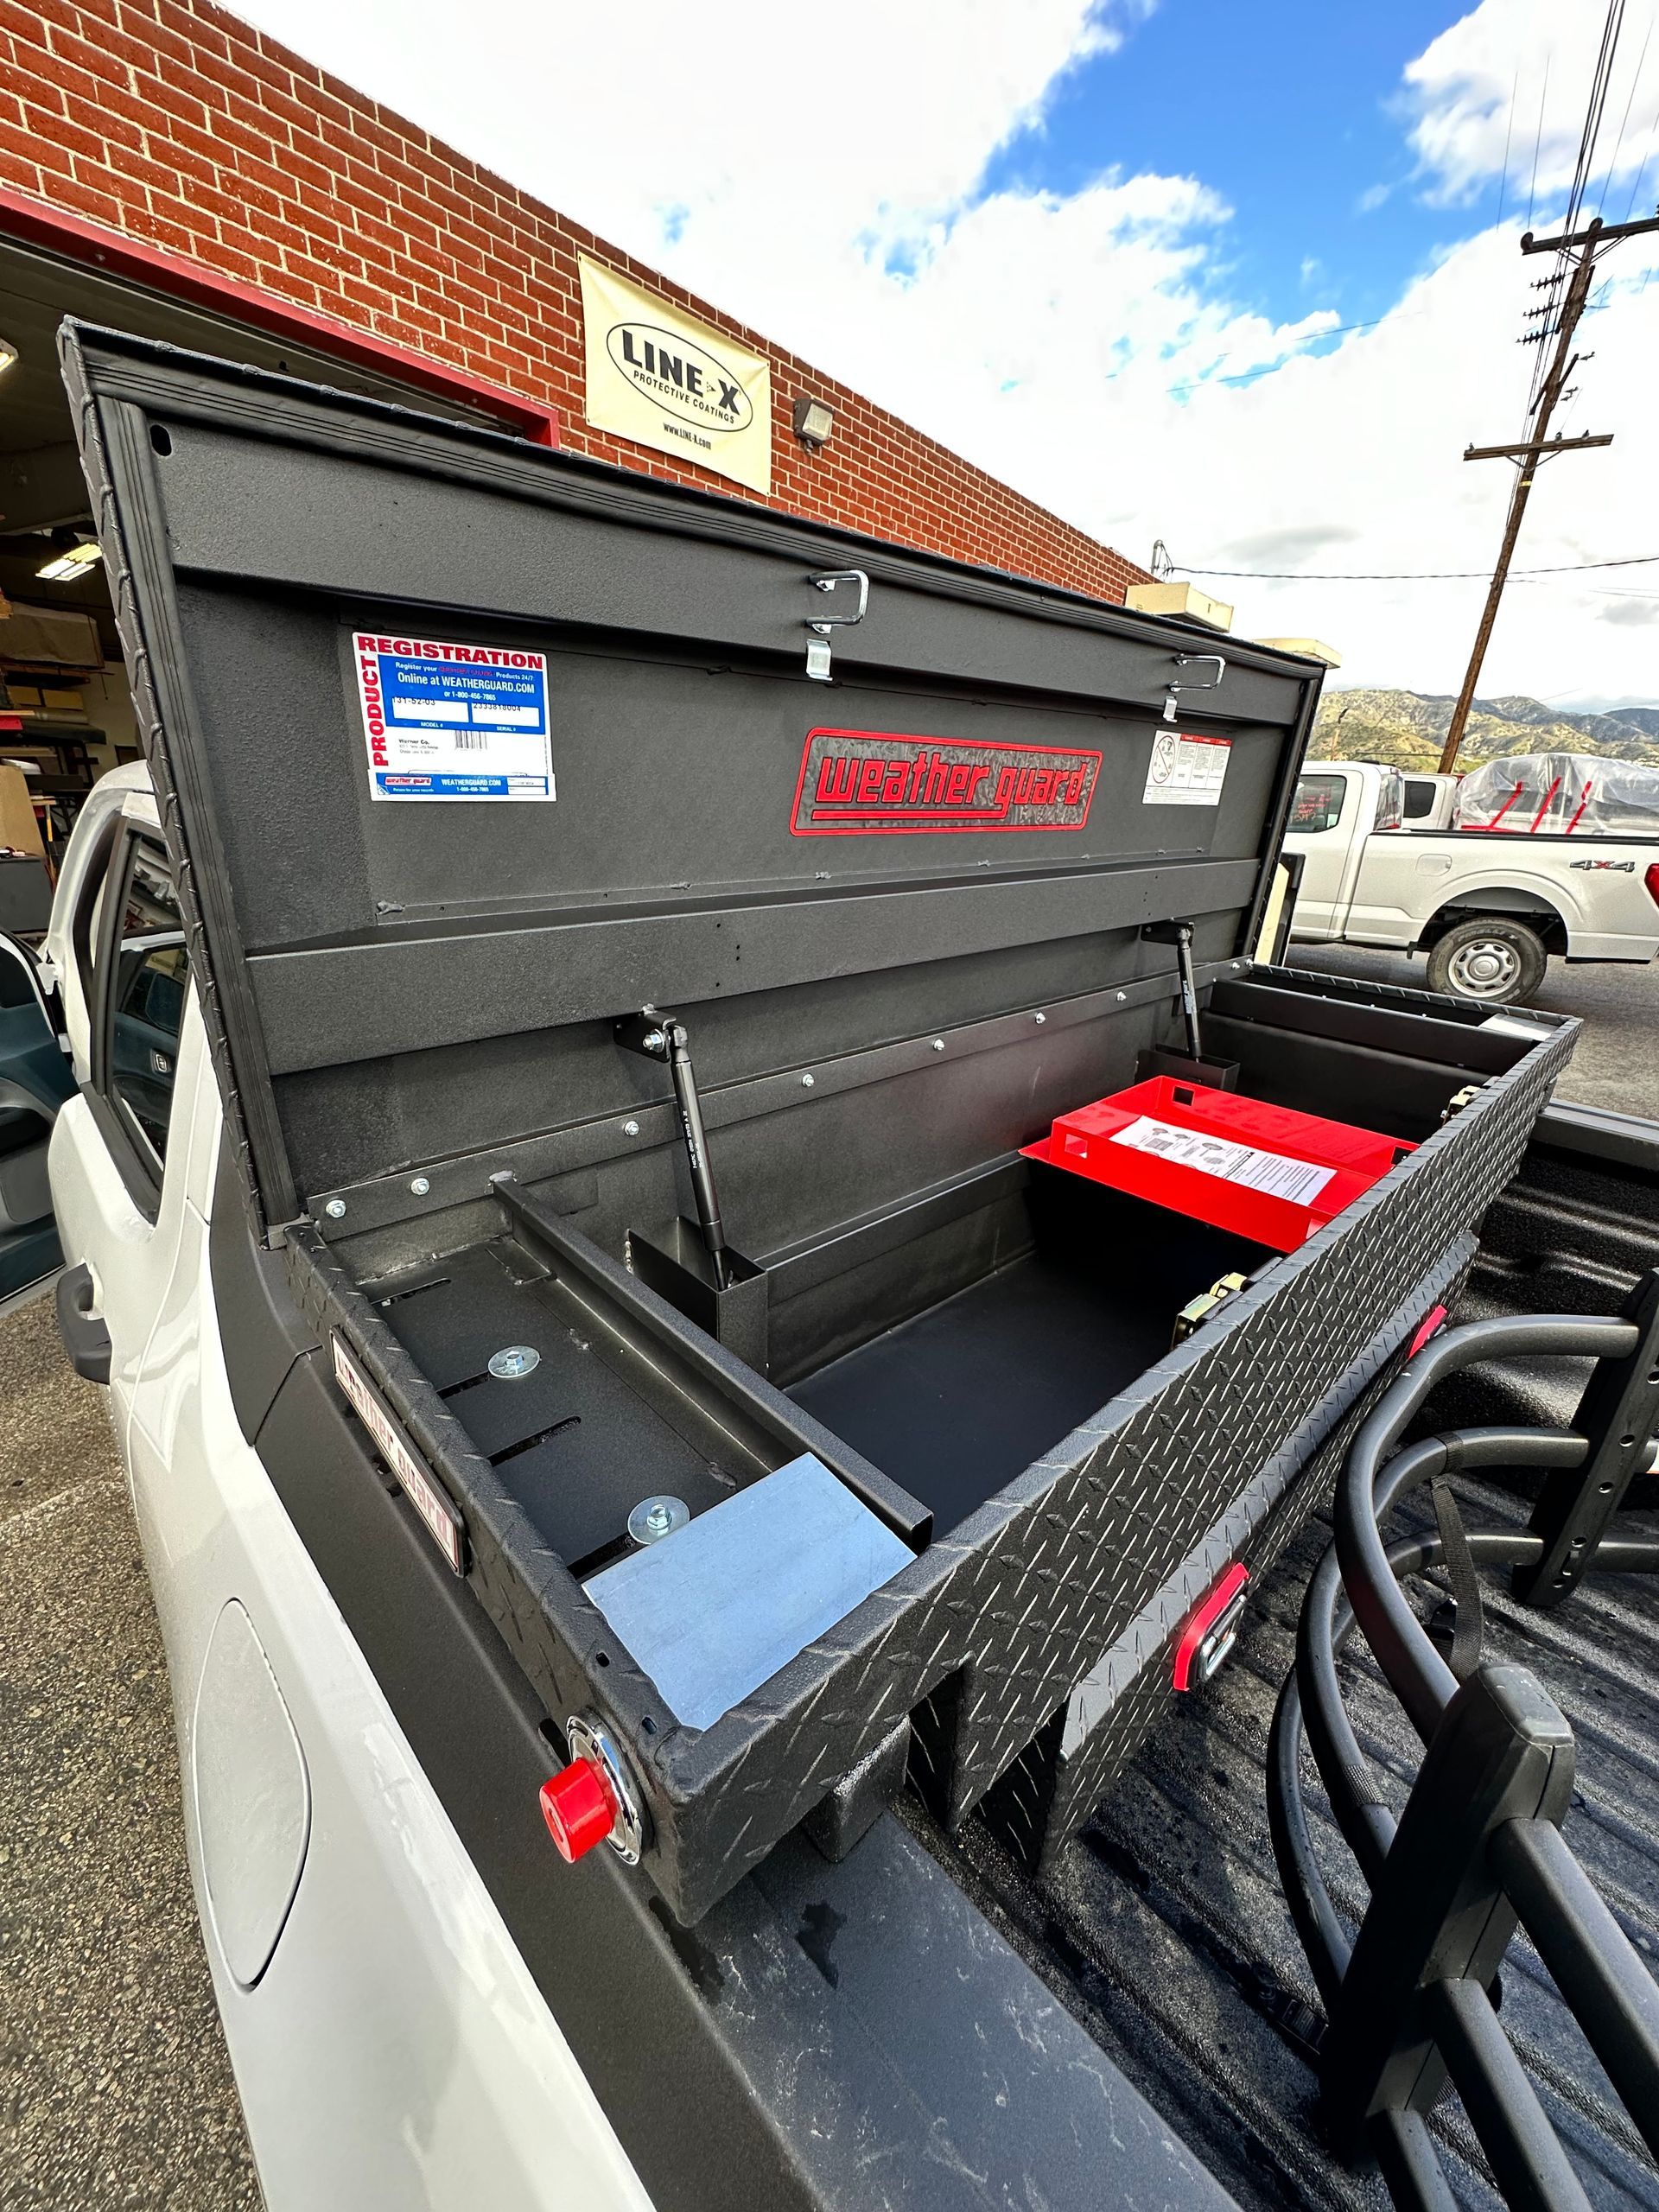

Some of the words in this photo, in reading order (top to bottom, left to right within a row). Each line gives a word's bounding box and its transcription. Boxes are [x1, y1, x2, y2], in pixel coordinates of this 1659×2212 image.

[633, 370, 690, 404] PROTECTIVE
[693, 398, 735, 424] COATINGS
[663, 423, 711, 450] www.LINE-X.com
[357, 636, 543, 670] REGISTRATION
[396, 662, 422, 672] Register
[496, 671, 520, 681] Products
[397, 671, 428, 685] Online
[430, 675, 441, 686] at
[442, 676, 535, 694] WEATHERGUARD.COM
[452, 690, 496, 701] 1-800-456-7865
[360, 656, 389, 766] PRODUCT
[815, 751, 991, 804] weather
[994, 761, 1087, 820] guard
